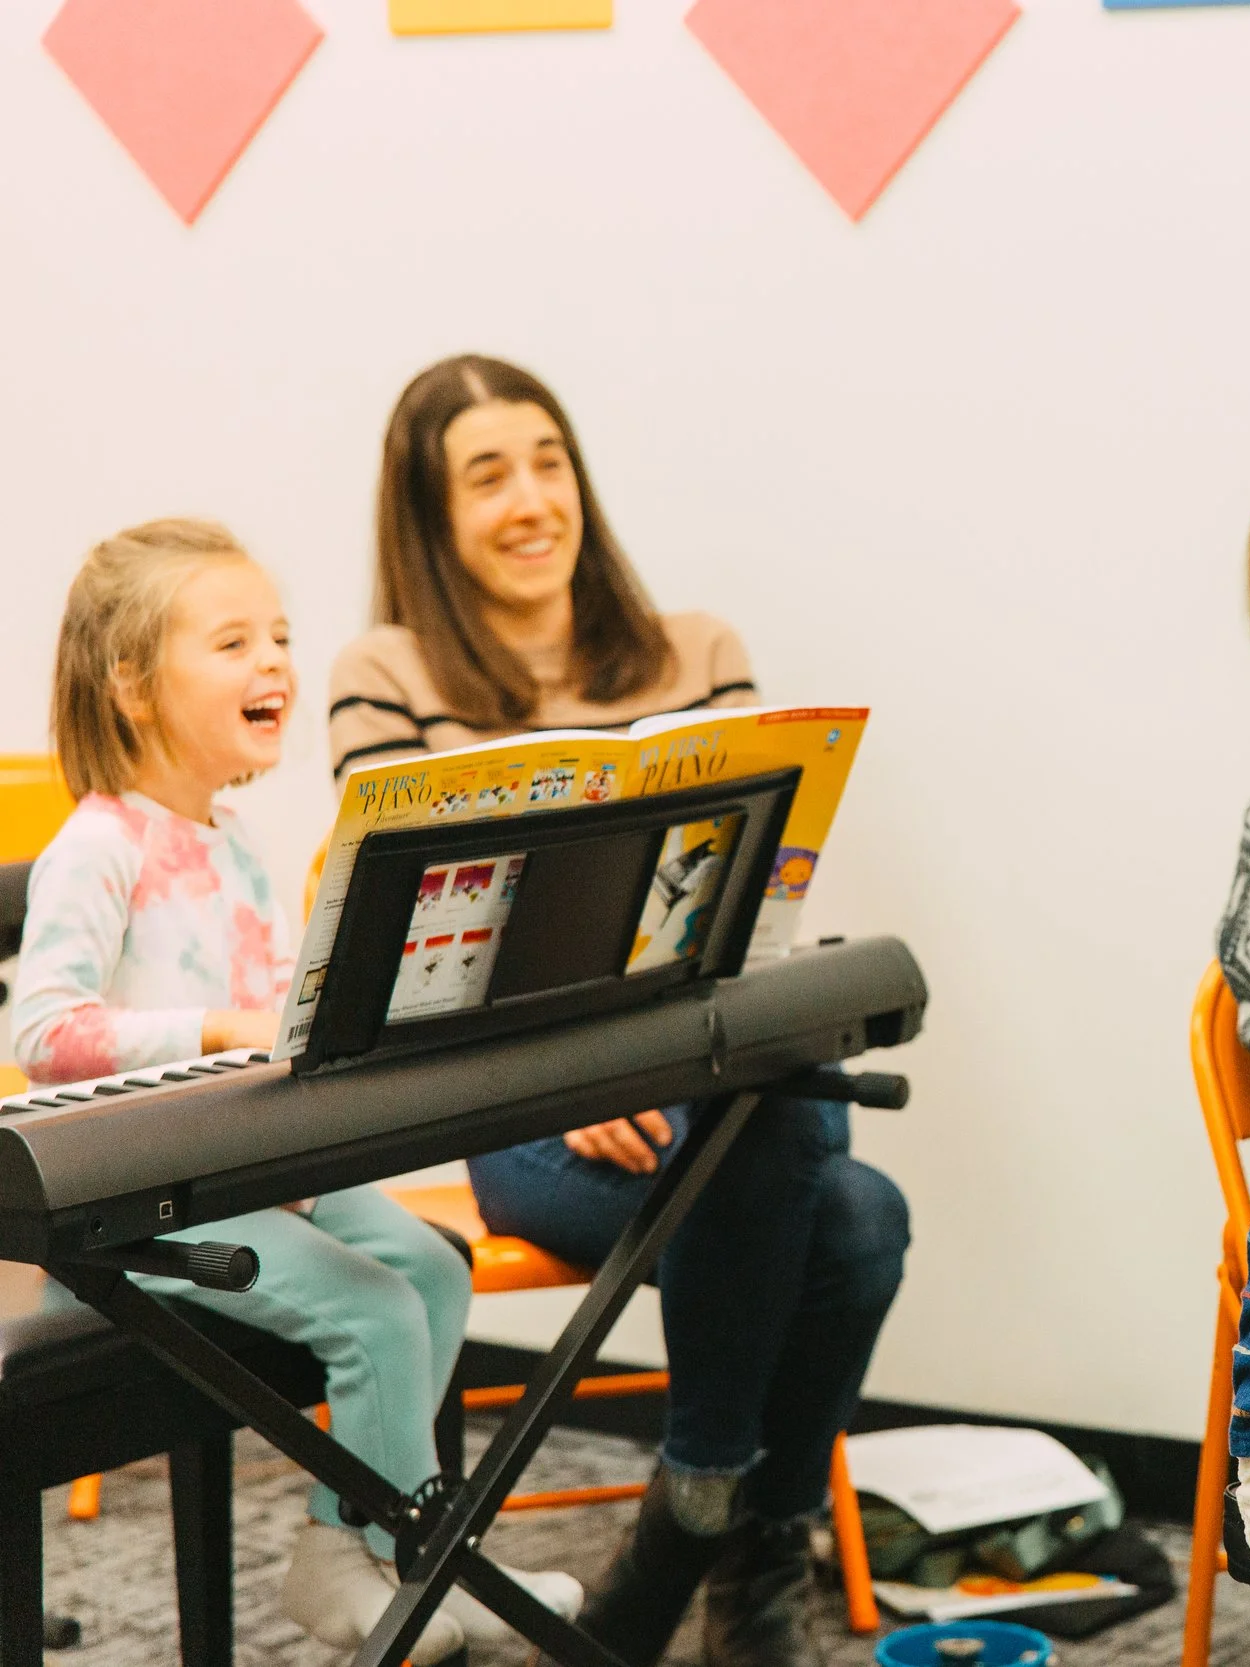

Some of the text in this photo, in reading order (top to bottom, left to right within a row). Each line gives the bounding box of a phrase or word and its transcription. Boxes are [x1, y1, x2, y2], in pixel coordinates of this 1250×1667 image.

[357, 770, 430, 798] MY FIRST
[640, 749, 728, 797] PIANO
[362, 784, 433, 814] PIANO
